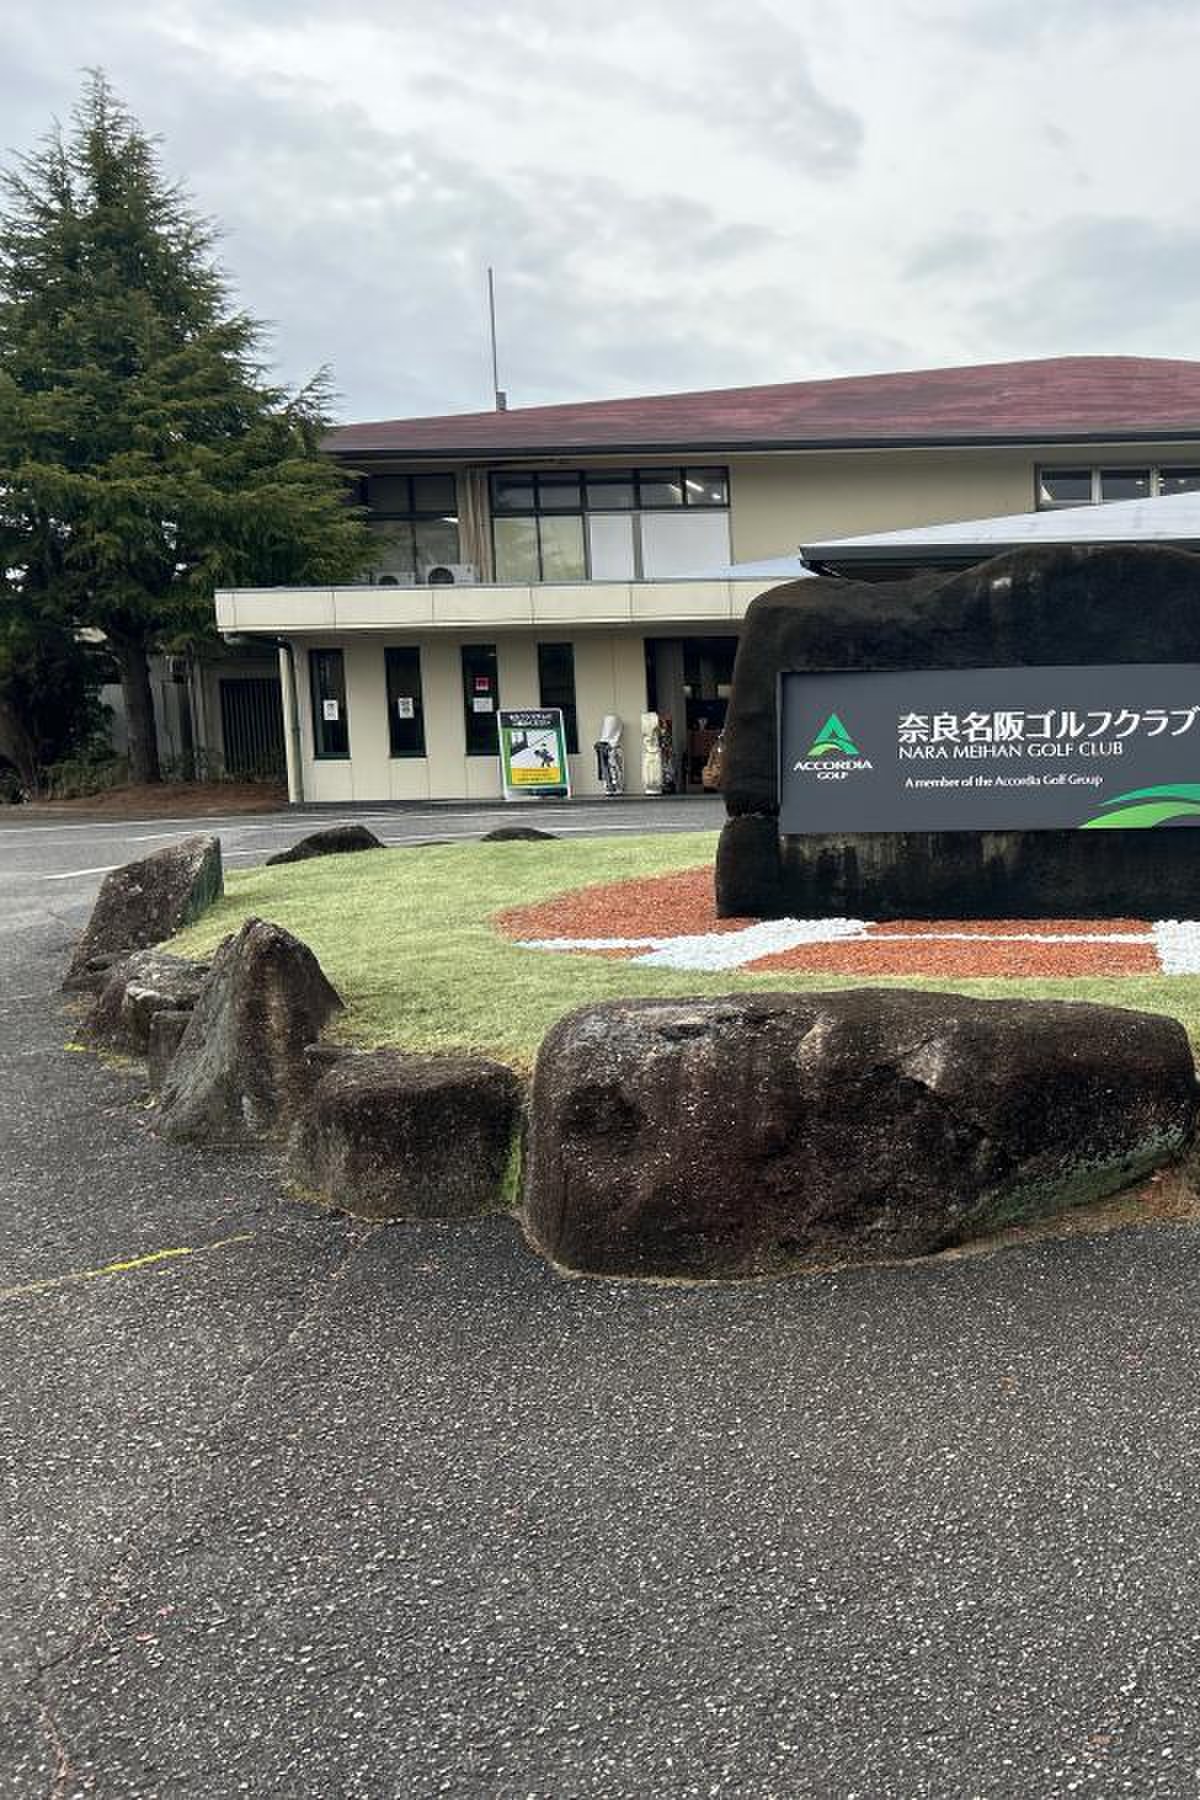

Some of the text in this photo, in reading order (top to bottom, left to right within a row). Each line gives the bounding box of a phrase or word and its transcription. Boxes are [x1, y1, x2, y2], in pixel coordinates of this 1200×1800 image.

[897, 705, 1200, 743] 奈良名阪ゴルフクラブ
[899, 741, 1124, 759] NARA MEIHAN GOLF CLUB
[793, 760, 873, 771] ACCORDIA
[816, 771, 849, 780] GOLF
[915, 776, 960, 787] member
[961, 775, 974, 786] of
[975, 775, 993, 786] the
[994, 774, 1041, 786] Accordia
[1042, 773, 1067, 785] Golf
[1067, 773, 1104, 788] Group
